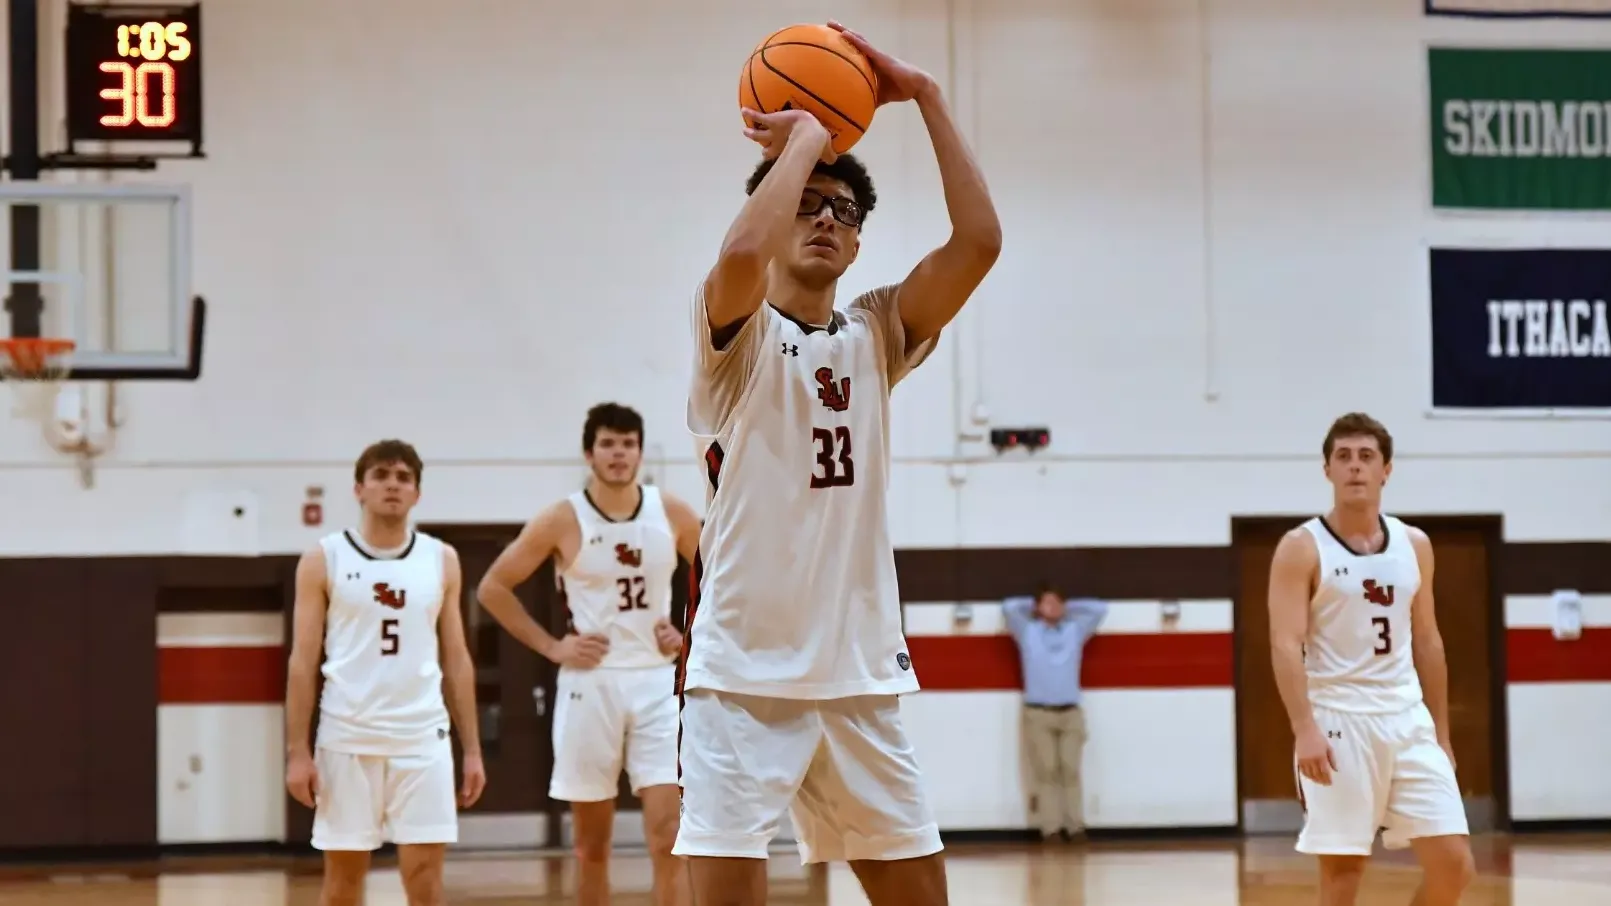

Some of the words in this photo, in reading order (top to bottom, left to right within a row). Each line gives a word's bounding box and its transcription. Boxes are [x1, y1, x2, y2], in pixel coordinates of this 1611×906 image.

[117, 22, 191, 61] 1:05
[99, 62, 176, 127] 30
[1486, 299, 1611, 357] ITHACA
[810, 426, 854, 488] 33
[616, 576, 649, 612] 32
[381, 619, 399, 655] 5
[1371, 616, 1392, 656] 3
